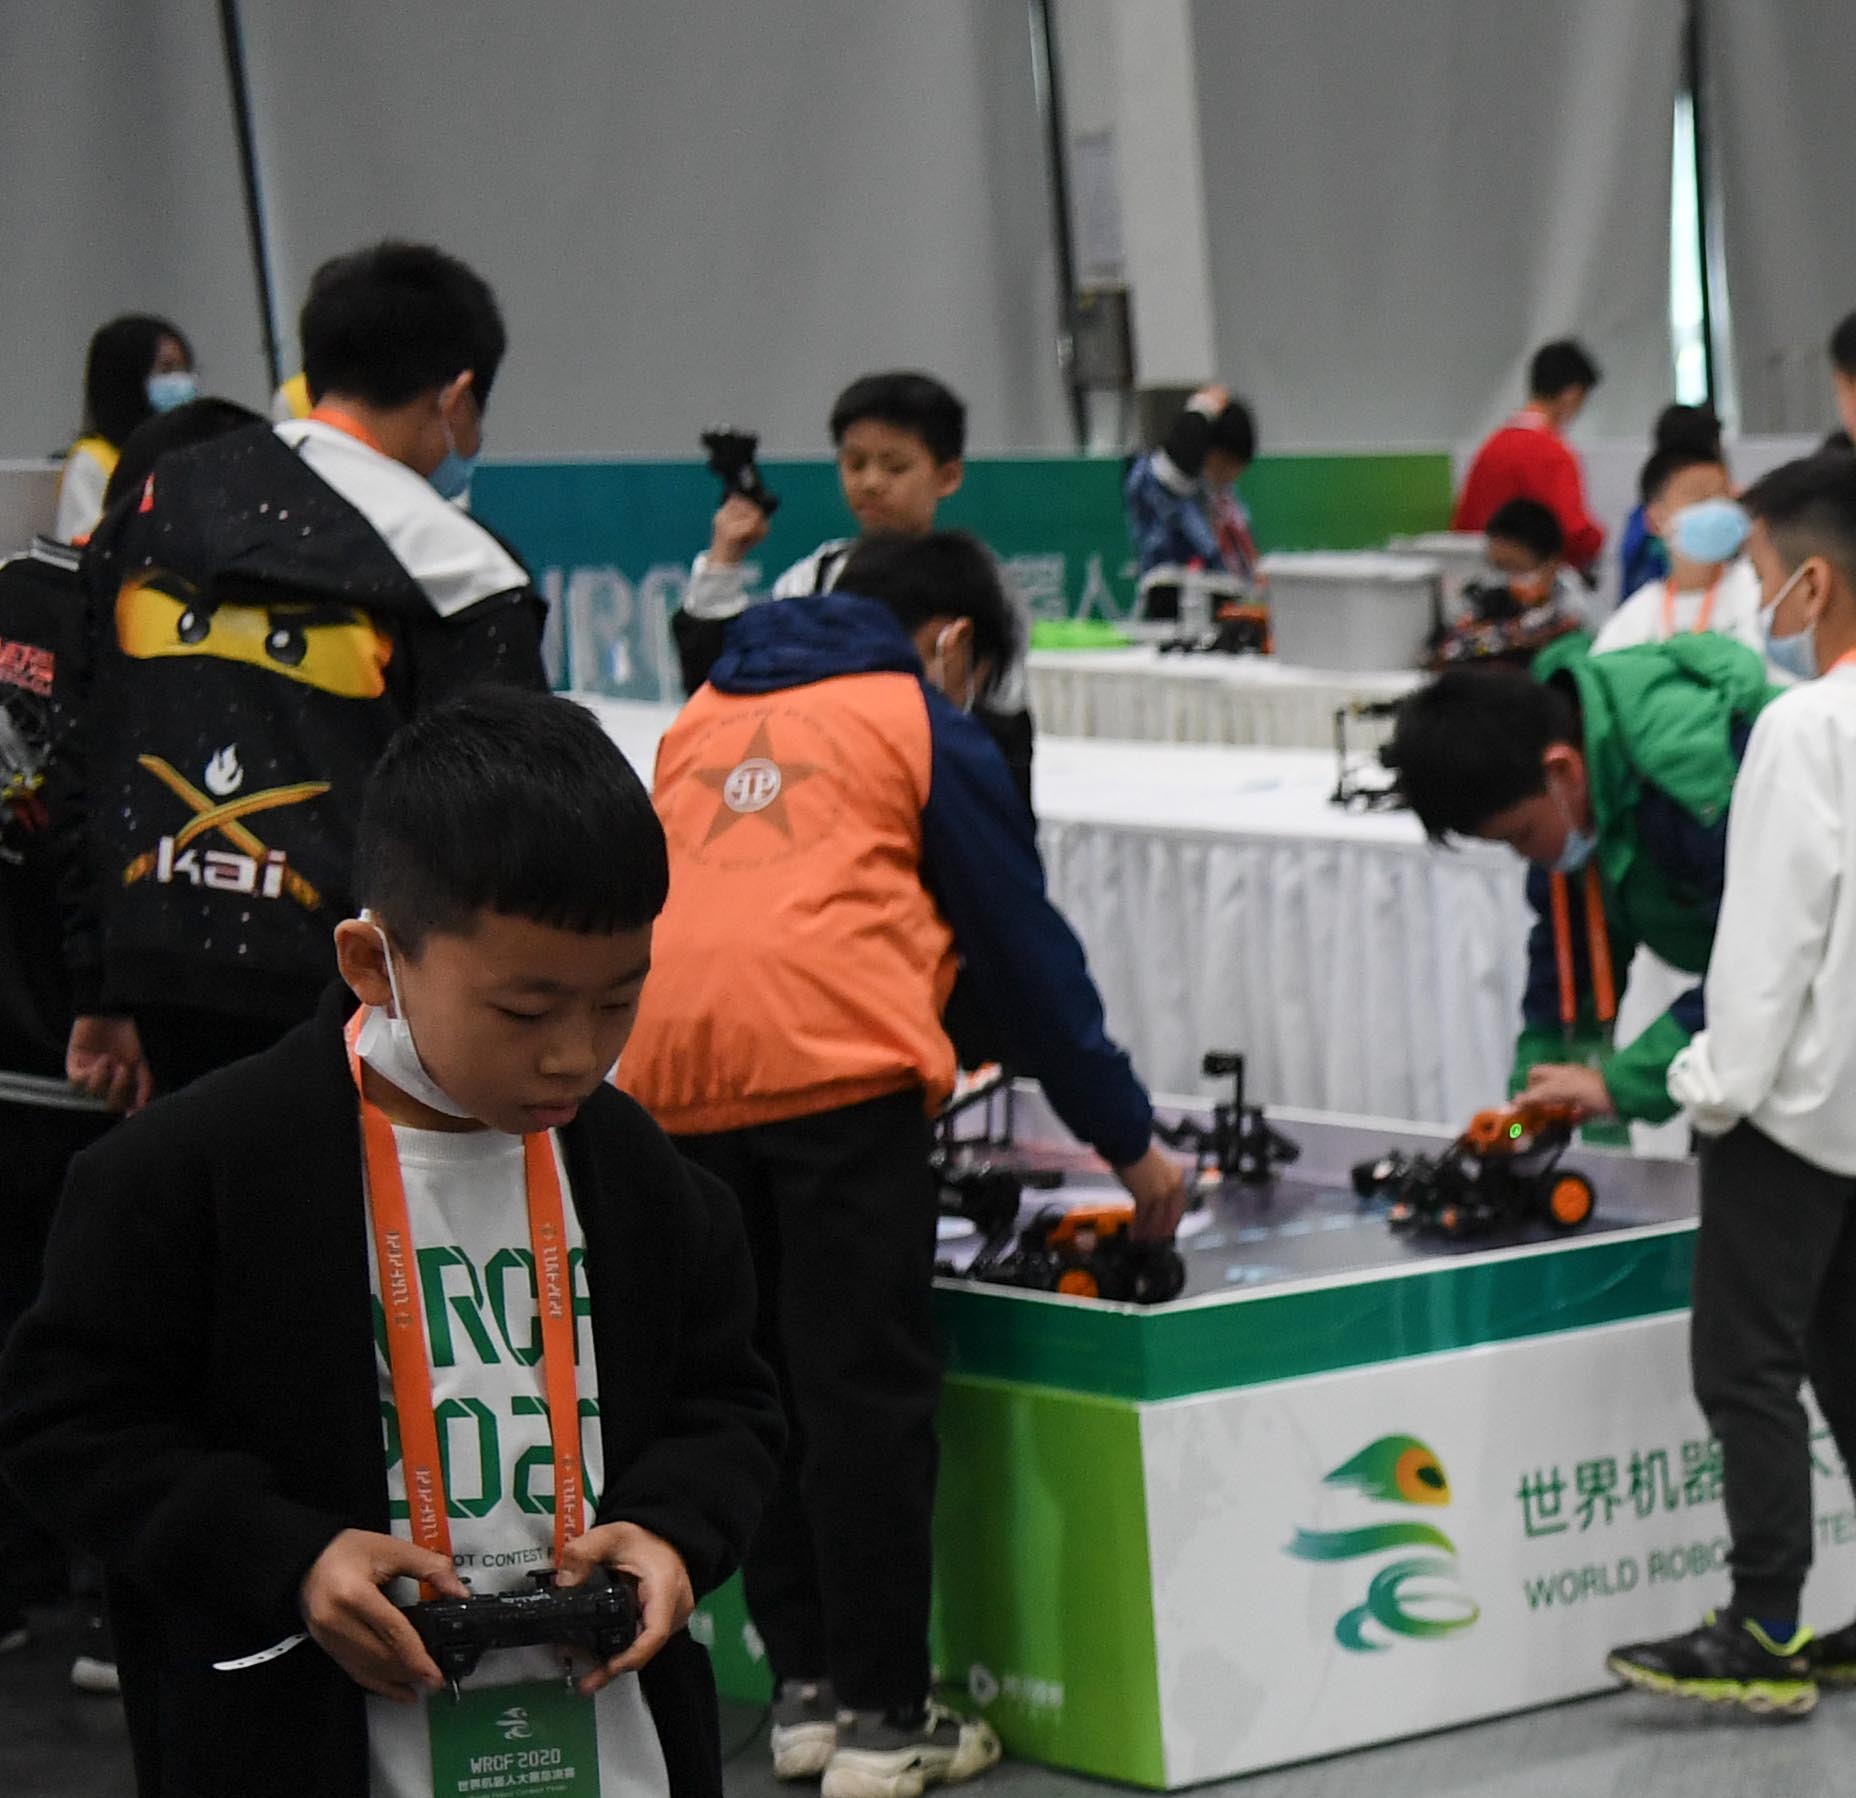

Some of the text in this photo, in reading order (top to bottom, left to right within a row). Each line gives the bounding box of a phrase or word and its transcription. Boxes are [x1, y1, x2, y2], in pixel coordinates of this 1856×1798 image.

[155, 835, 287, 899] kai
[482, 1547, 543, 1568] CONTEST
[1523, 1537, 1729, 1610] WORLD ROBO
[470, 1748, 561, 1775] WRCF 2020
